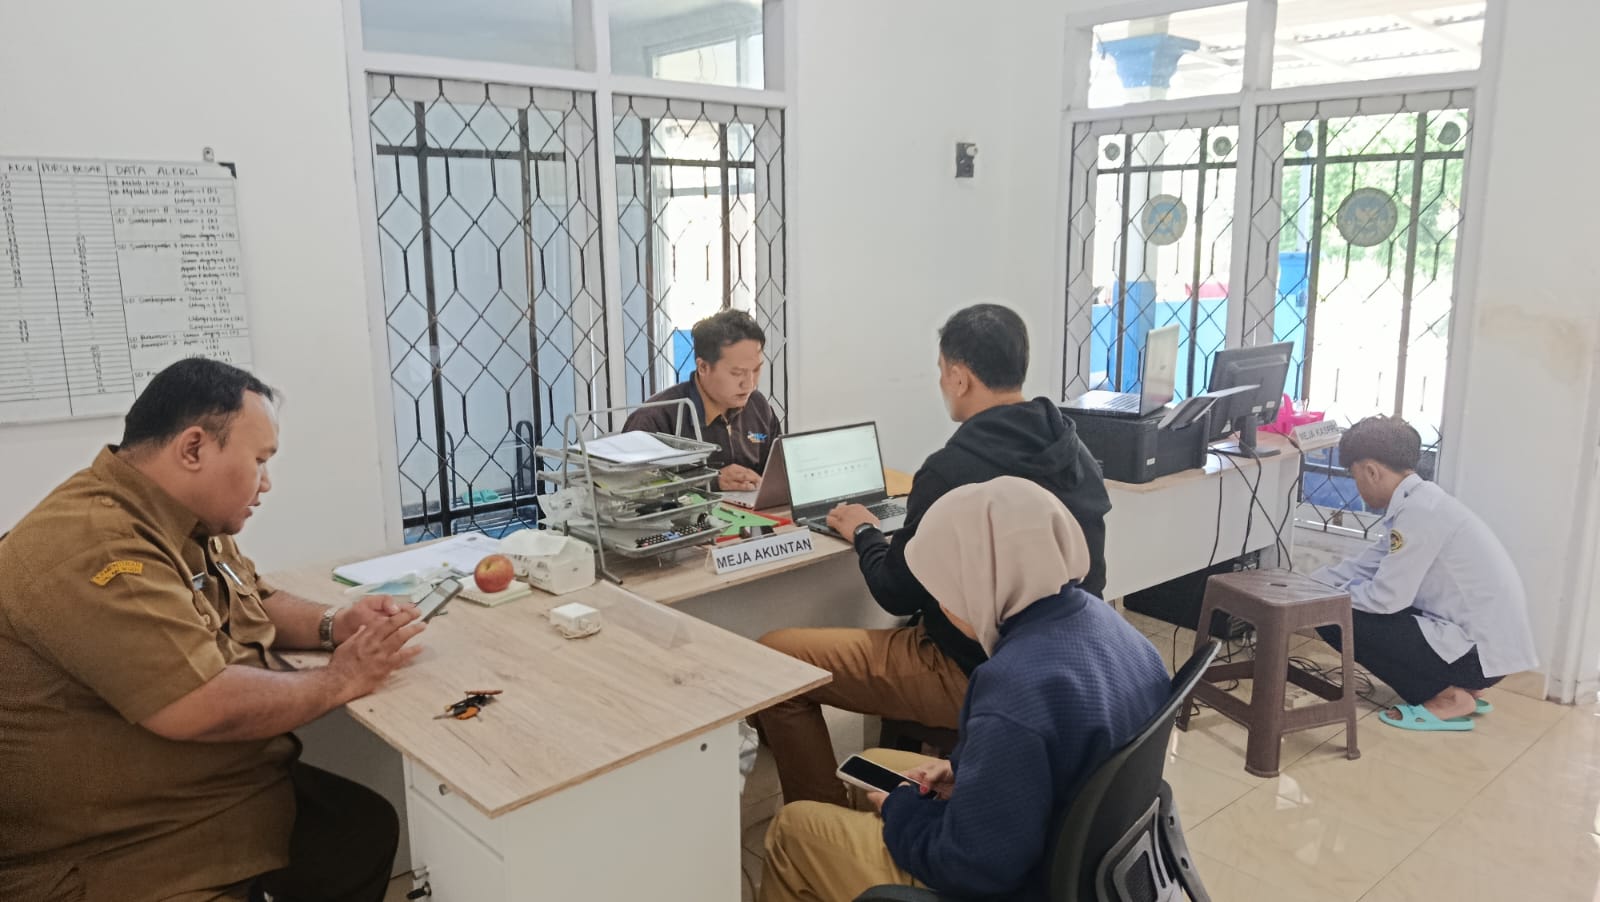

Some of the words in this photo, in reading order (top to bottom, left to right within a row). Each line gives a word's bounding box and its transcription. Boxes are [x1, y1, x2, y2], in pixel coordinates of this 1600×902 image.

[115, 165, 146, 176] DATA
[157, 166, 199, 176] ALERGI
[716, 551, 751, 569] MEJA
[755, 538, 812, 560] AKUNTAN
